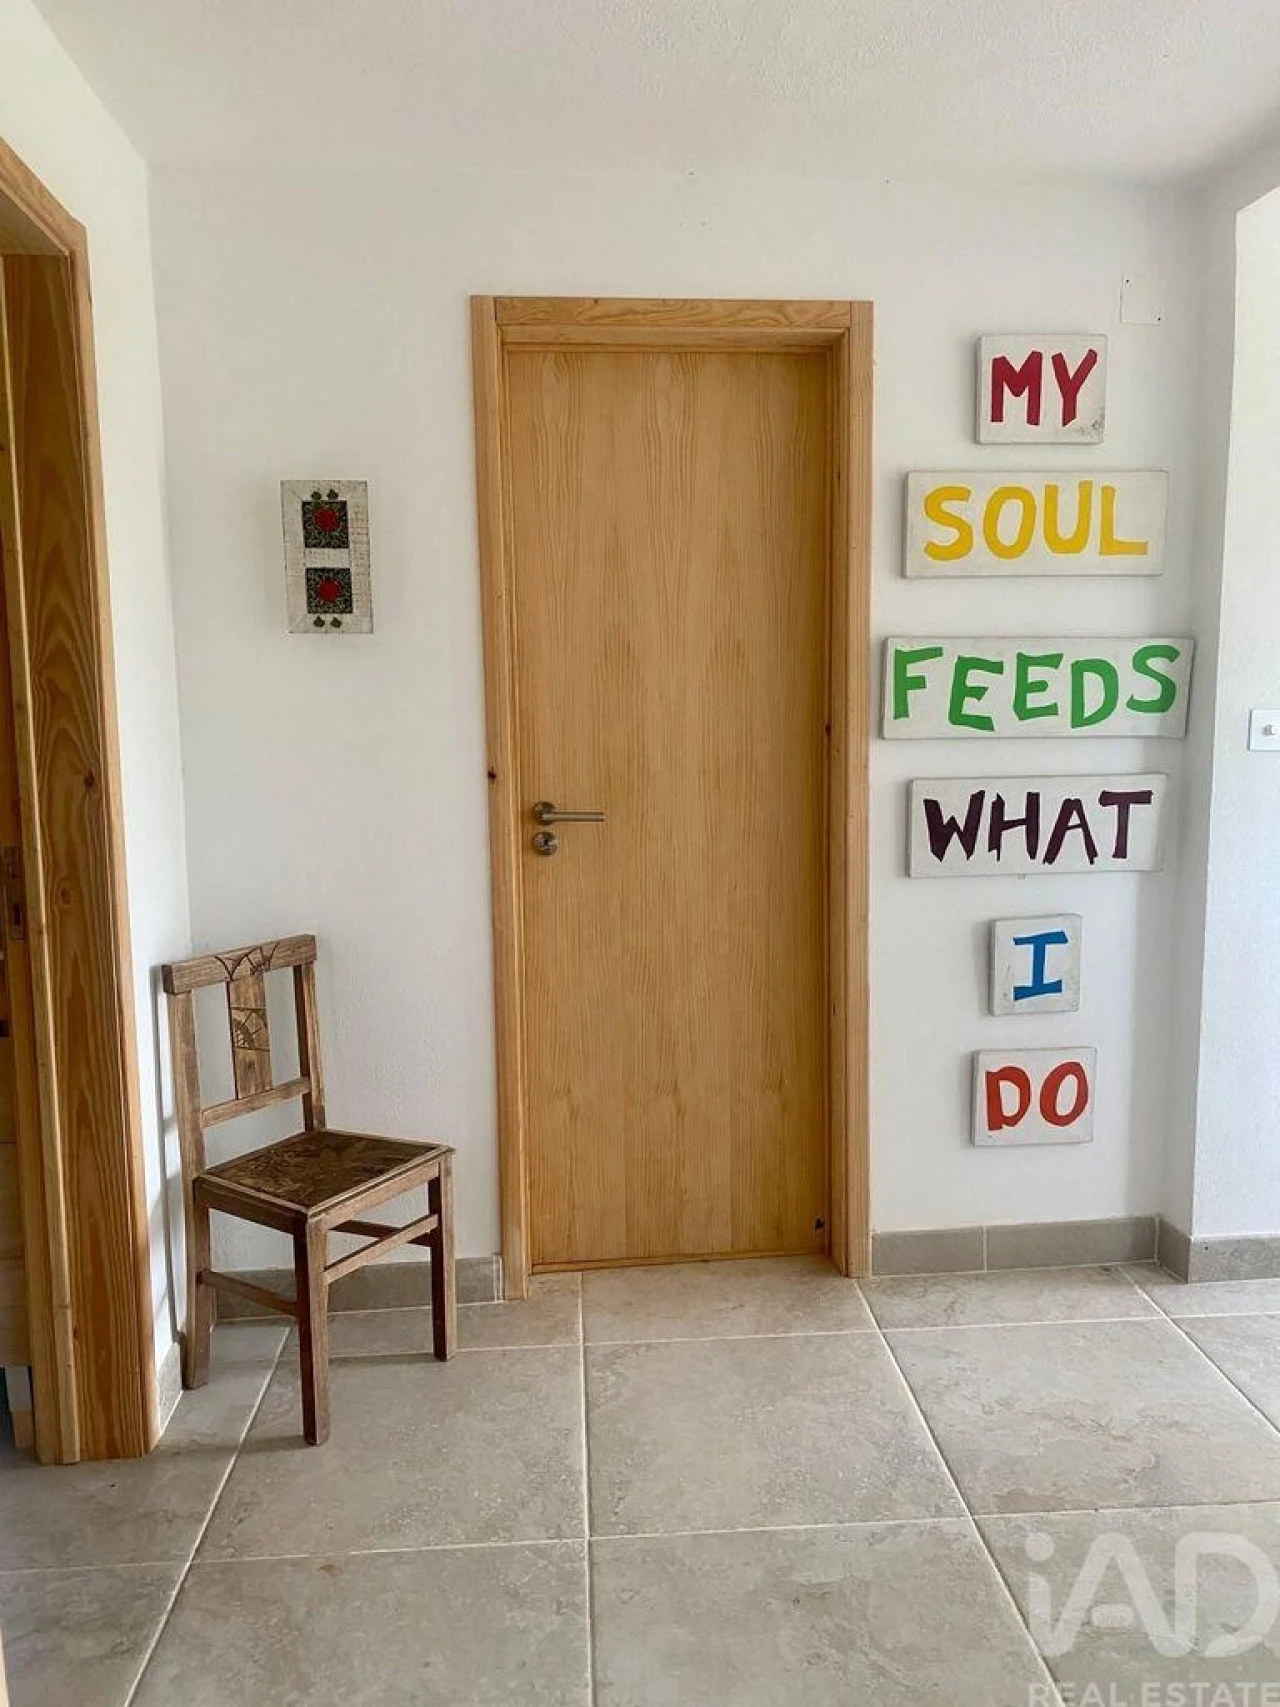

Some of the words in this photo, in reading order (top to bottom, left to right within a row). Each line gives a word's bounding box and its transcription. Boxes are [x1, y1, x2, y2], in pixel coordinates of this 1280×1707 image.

[990, 348, 1098, 427] MY
[923, 480, 1149, 560] SOUL
[892, 644, 1181, 732] FEEDS
[923, 788, 1153, 864] WHAT
[1013, 930, 1068, 1000] I
[985, 1060, 1090, 1130] DO
